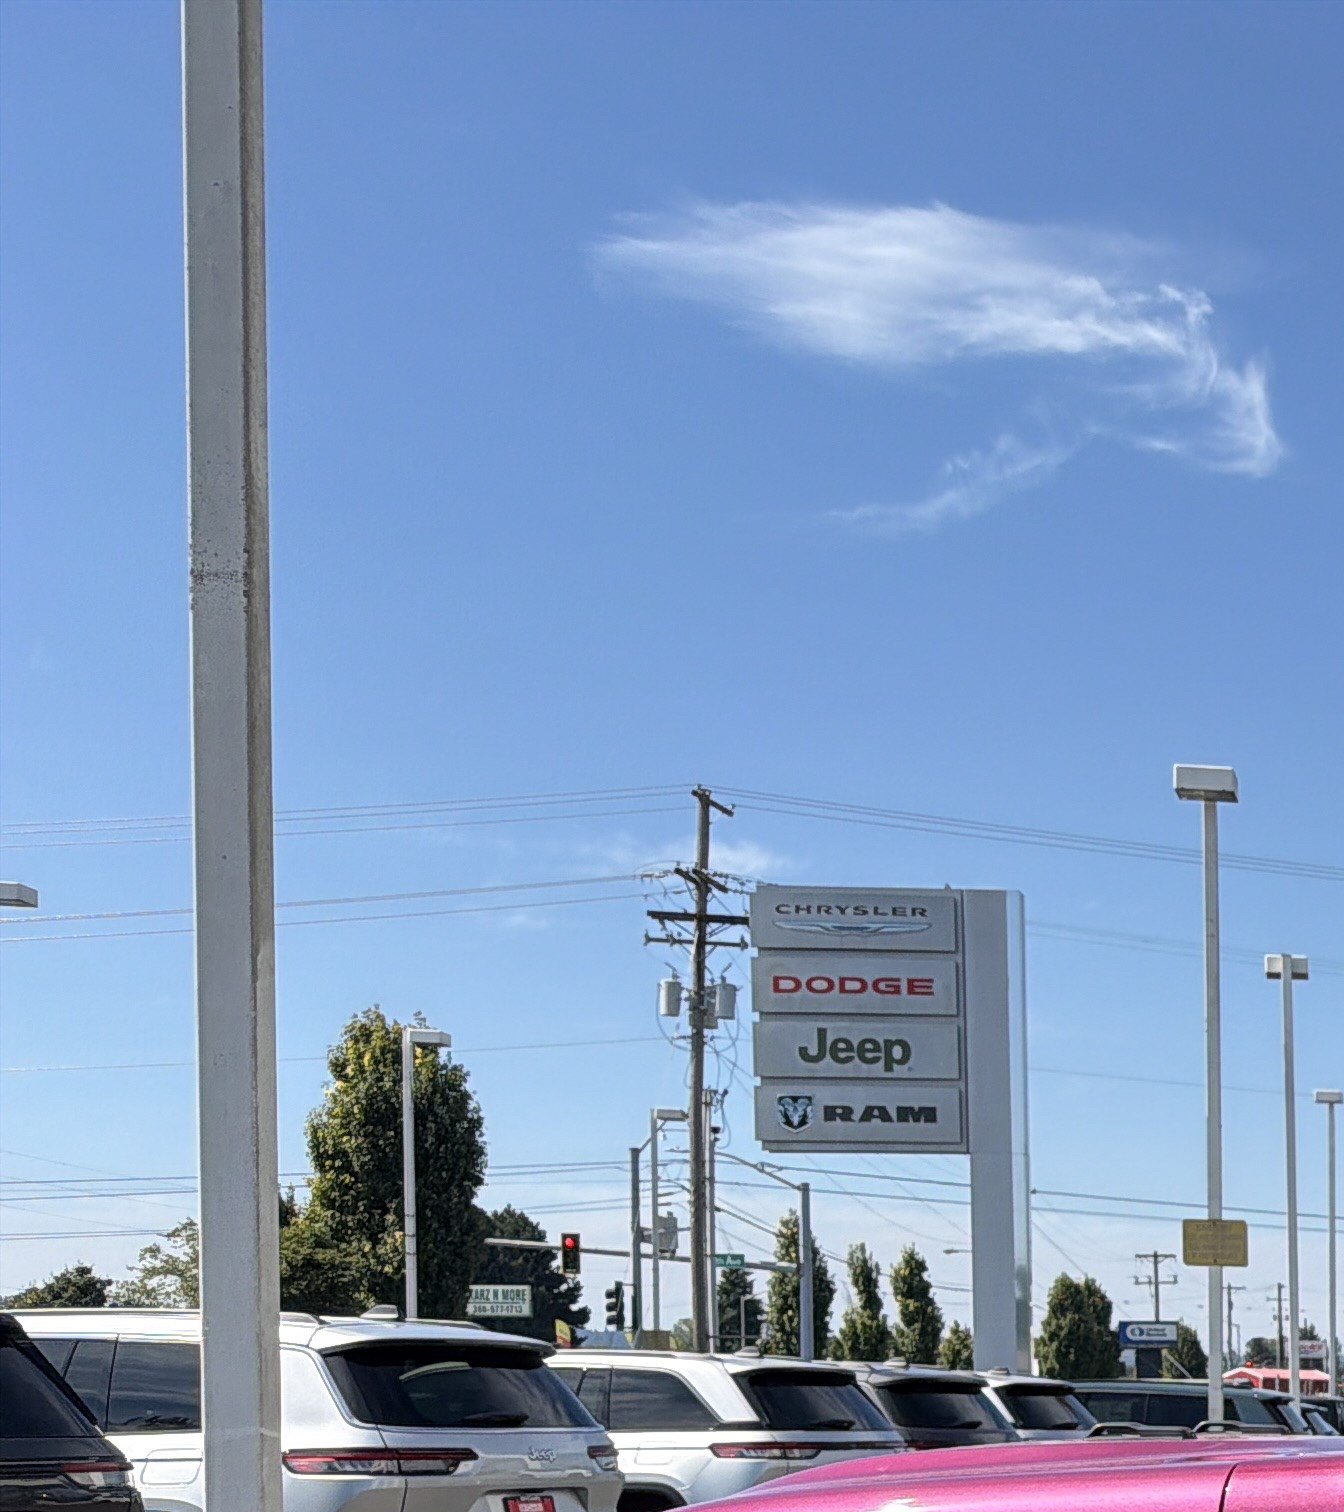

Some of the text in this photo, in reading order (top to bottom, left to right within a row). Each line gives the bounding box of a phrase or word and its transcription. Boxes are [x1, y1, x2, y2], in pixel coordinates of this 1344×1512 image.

[774, 903, 928, 918] CHRYSLER
[772, 975, 935, 996] DODGE
[798, 1027, 911, 1072] Jeep
[823, 1104, 937, 1124] RAM
[501, 1288, 527, 1302] MORE
[528, 1446, 557, 1463] Jeep
